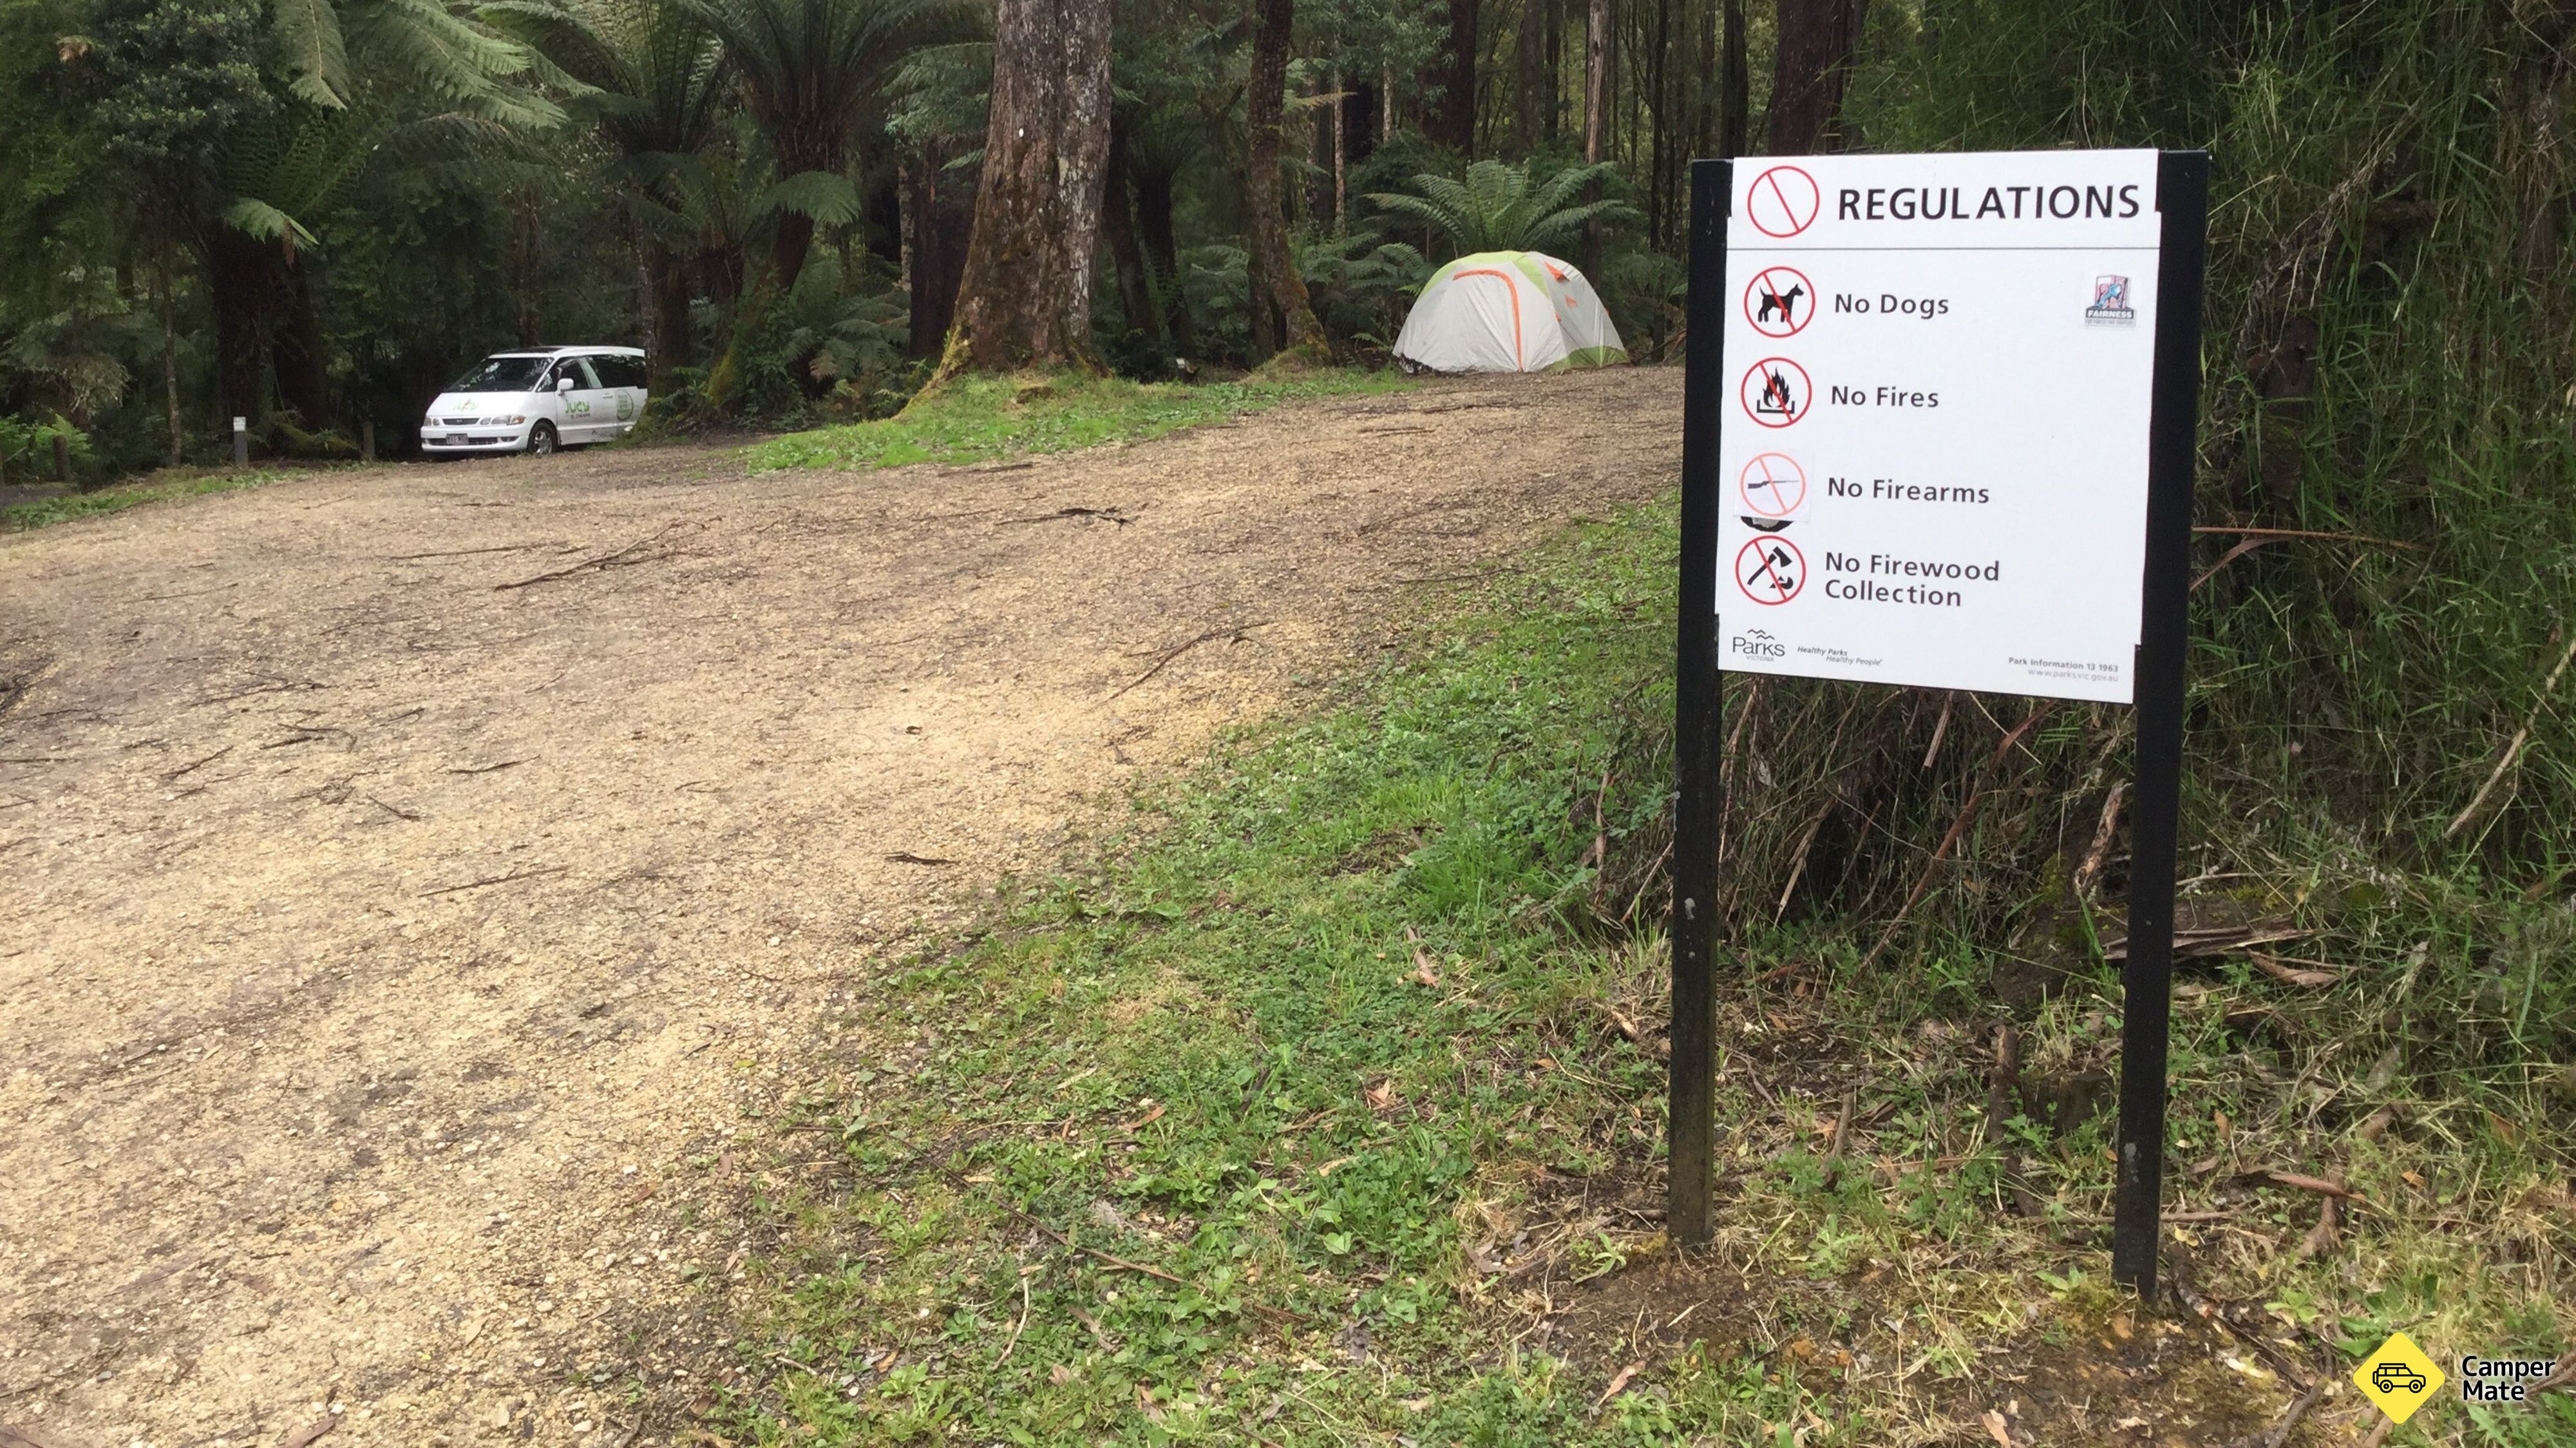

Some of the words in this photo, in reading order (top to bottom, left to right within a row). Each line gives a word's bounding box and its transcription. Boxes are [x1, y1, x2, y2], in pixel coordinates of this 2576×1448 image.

[1839, 185, 2139, 220] REGULATIONS
[1835, 294, 1870, 314] No
[1880, 294, 1949, 319] Dogs
[2087, 310, 2132, 318] FAIRNESS
[1832, 386, 1866, 406] No
[1877, 386, 1938, 408] Fires
[1828, 477, 1862, 498] No
[1873, 479, 1989, 503] Firearms
[1826, 552, 1860, 573] No
[1870, 555, 2000, 581] Firewood
[1826, 579, 1961, 607] Collection
[1732, 636, 1785, 657] Parks
[1797, 646, 1826, 656] Healthy
[1826, 656, 1853, 665] Healthy
[2031, 659, 2084, 669] Information
[2099, 664, 2119, 672] 1963
[2028, 669, 2119, 681] www.parks.vic.gov.au
